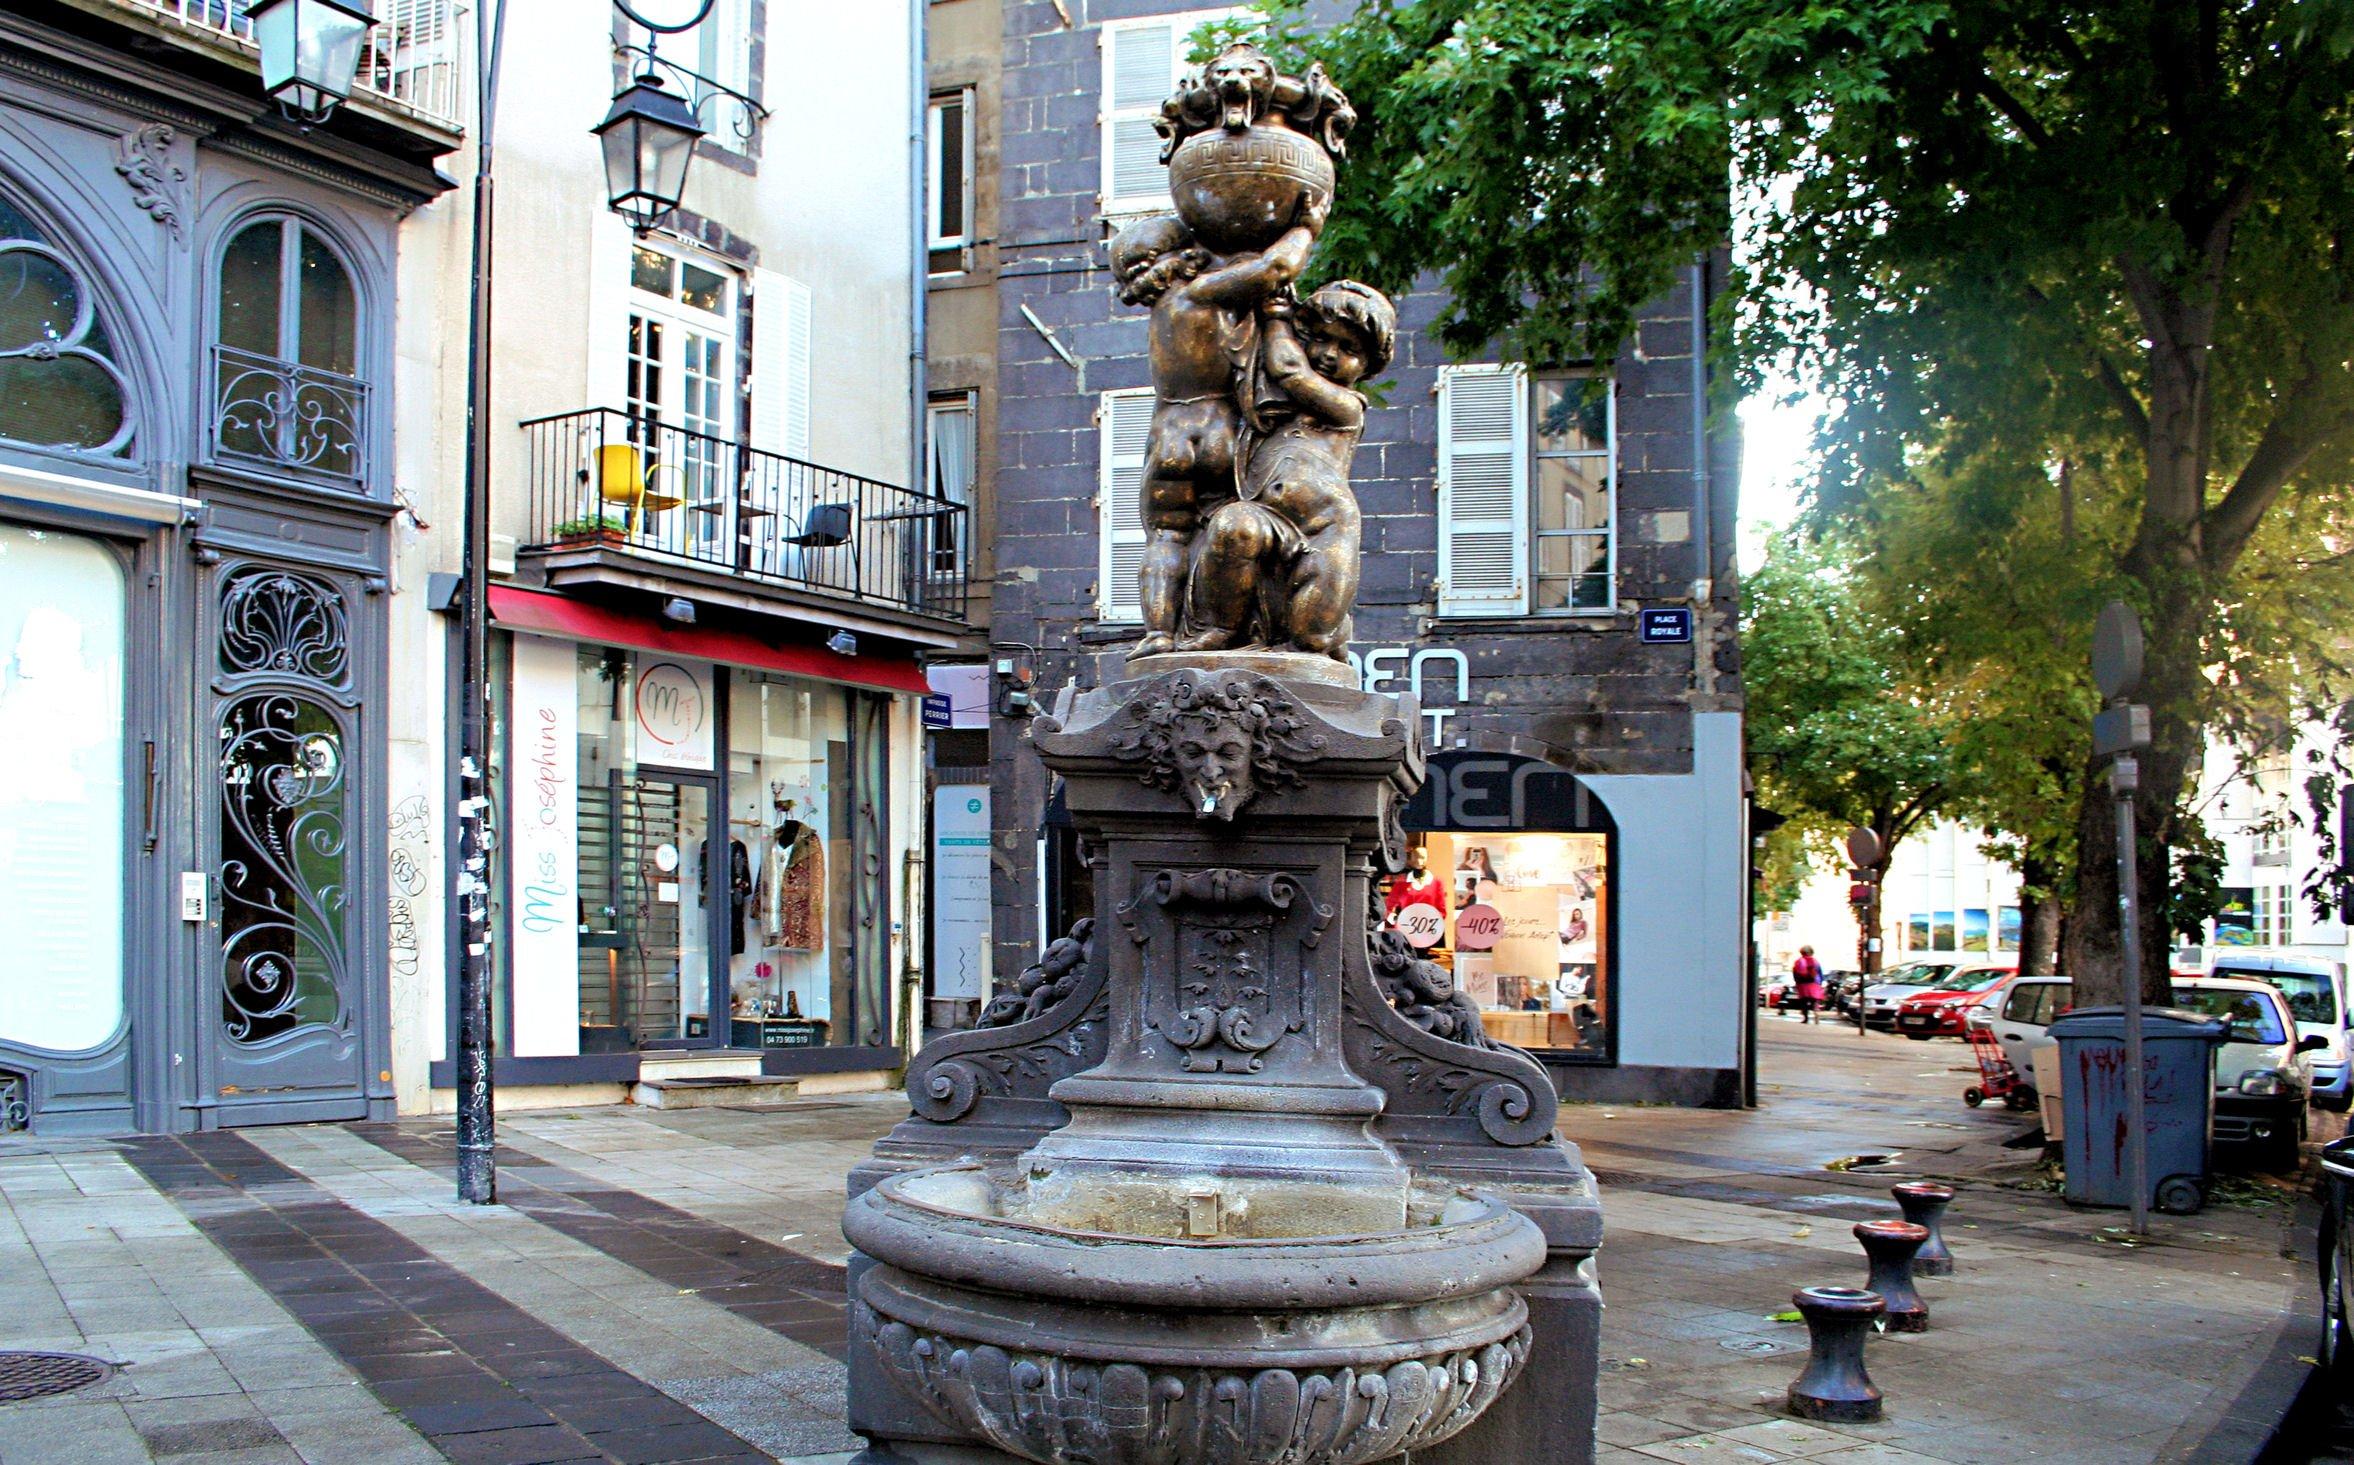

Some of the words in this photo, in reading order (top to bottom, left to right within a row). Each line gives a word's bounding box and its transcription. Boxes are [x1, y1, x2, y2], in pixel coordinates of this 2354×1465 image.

[1654, 615, 1677, 623] PLACE
[1650, 627, 1682, 635] ROYALE
[925, 709, 949, 720] PERRIER
[521, 852, 568, 933] Miss
[1401, 917, 1440, 935] -30%
